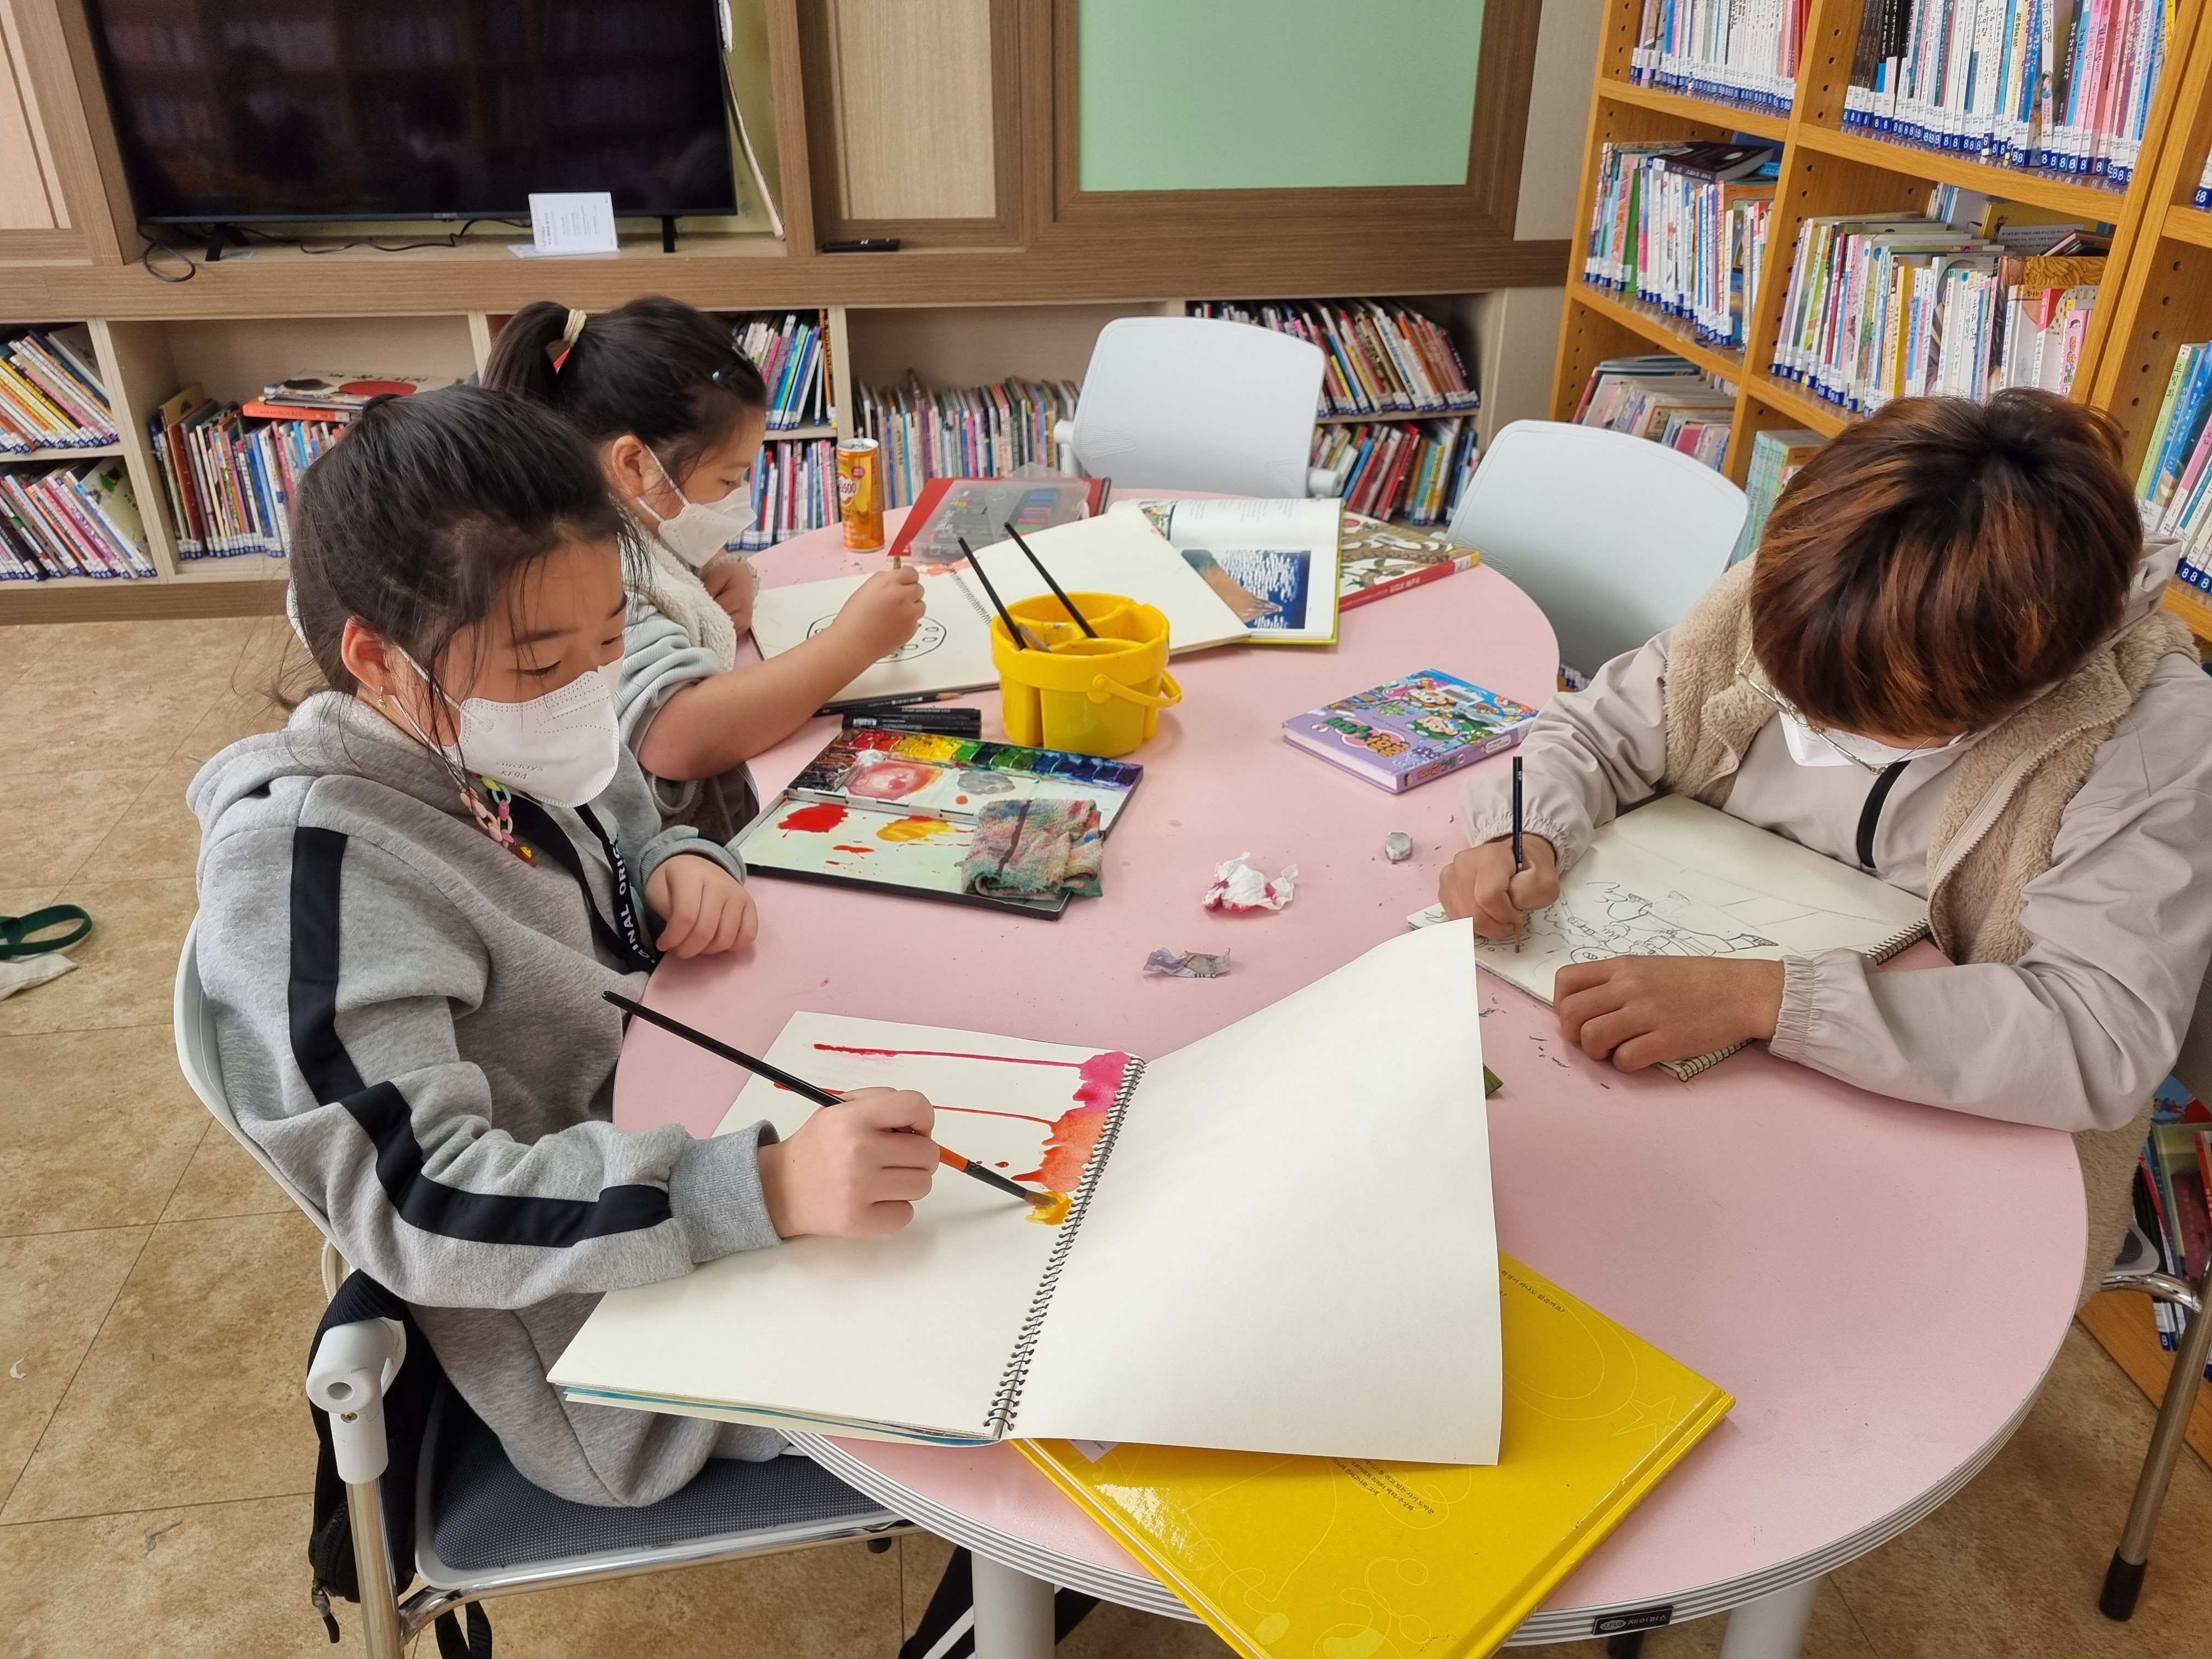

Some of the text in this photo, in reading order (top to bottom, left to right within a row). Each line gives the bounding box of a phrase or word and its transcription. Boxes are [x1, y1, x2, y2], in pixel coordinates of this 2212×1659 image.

[2042, 18, 2052, 43] 잎새
[2063, 54, 2072, 80] 모나리자
[1843, 111, 1847, 120] 8
[1850, 112, 1855, 121] 8
[1857, 114, 1860, 122] 8
[1864, 115, 1868, 124] 8
[1875, 119, 1879, 128] 8
[1883, 120, 1888, 129] 8
[1894, 122, 1898, 131] 8
[1898, 124, 1902, 133] 8
[1904, 125, 1908, 134] 8
[1909, 126, 1914, 136] 8
[1917, 129, 1921, 138] 8
[1924, 132, 1929, 142] 8
[1930, 134, 1934, 143] 8
[1936, 134, 1940, 144] 8
[1944, 136, 1949, 146] 8
[1984, 136, 1988, 146] 8
[1953, 138, 1957, 147] 8
[1964, 139, 1968, 148] 8
[1970, 140, 1974, 150] 8
[1977, 140, 1981, 150] 8
[2007, 139, 2012, 149] 8
[1993, 143, 1997, 153] 8
[2000, 144, 2005, 154] 8
[2013, 151, 2018, 161] 8
[2018, 153, 2023, 163] 8
[2042, 154, 2047, 163] 8
[2051, 156, 2056, 166] 8
[2060, 157, 2066, 167] 8
[2069, 159, 2076, 168] 8
[2080, 160, 2086, 170] 8
[2096, 162, 2102, 172] 8
[2113, 168, 2118, 178] 8
[2118, 170, 2124, 180] 8
[2127, 172, 2132, 182] 8
[2200, 191, 2207, 203] 8
[2063, 336, 2076, 383] 흔한남매
[2181, 567, 2189, 578] 8
[2190, 571, 2198, 582] 8
[2200, 578, 2209, 589] 8
[496, 760, 544, 772] airdays
[500, 770, 527, 780] KF94
[1519, 1280, 1538, 1296] 하나도
[1536, 1293, 1566, 1314] 없을까요?
[2162, 1333, 2168, 1346] 8
[1350, 1460, 1372, 1479] 게르하르트
[1371, 1476, 1387, 1490] 리히터
[1346, 1467, 1368, 1487] 프라고나르
[1367, 1485, 1380, 1496] 그네
[1384, 1474, 1397, 1485] 쥐고
[1395, 1482, 1408, 1493] 있는
[1406, 1491, 1420, 1502] 사기
[1417, 1498, 1435, 1515] 도박꾼
[1601, 1621, 1624, 1630] J.FUS
